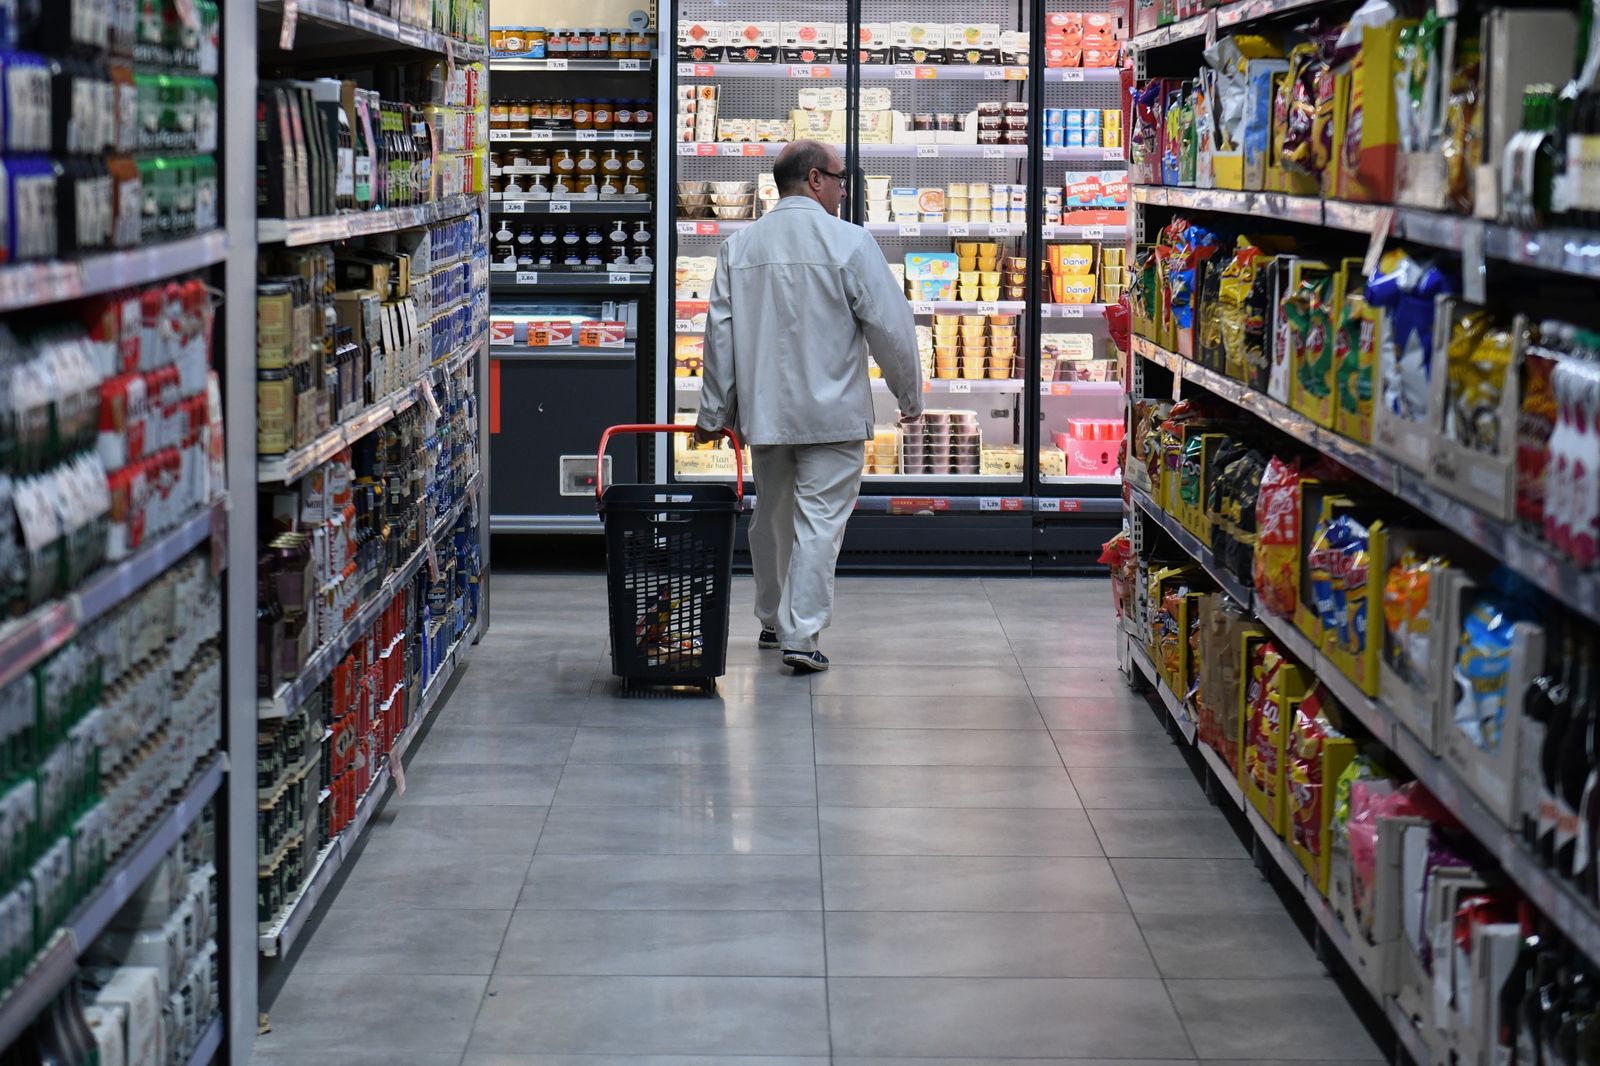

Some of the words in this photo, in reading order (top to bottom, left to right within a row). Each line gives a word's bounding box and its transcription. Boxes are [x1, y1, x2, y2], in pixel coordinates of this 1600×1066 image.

[1070, 182, 1100, 194] Royal
[1062, 257, 1089, 266] Danet
[1065, 286, 1092, 294] Danet
